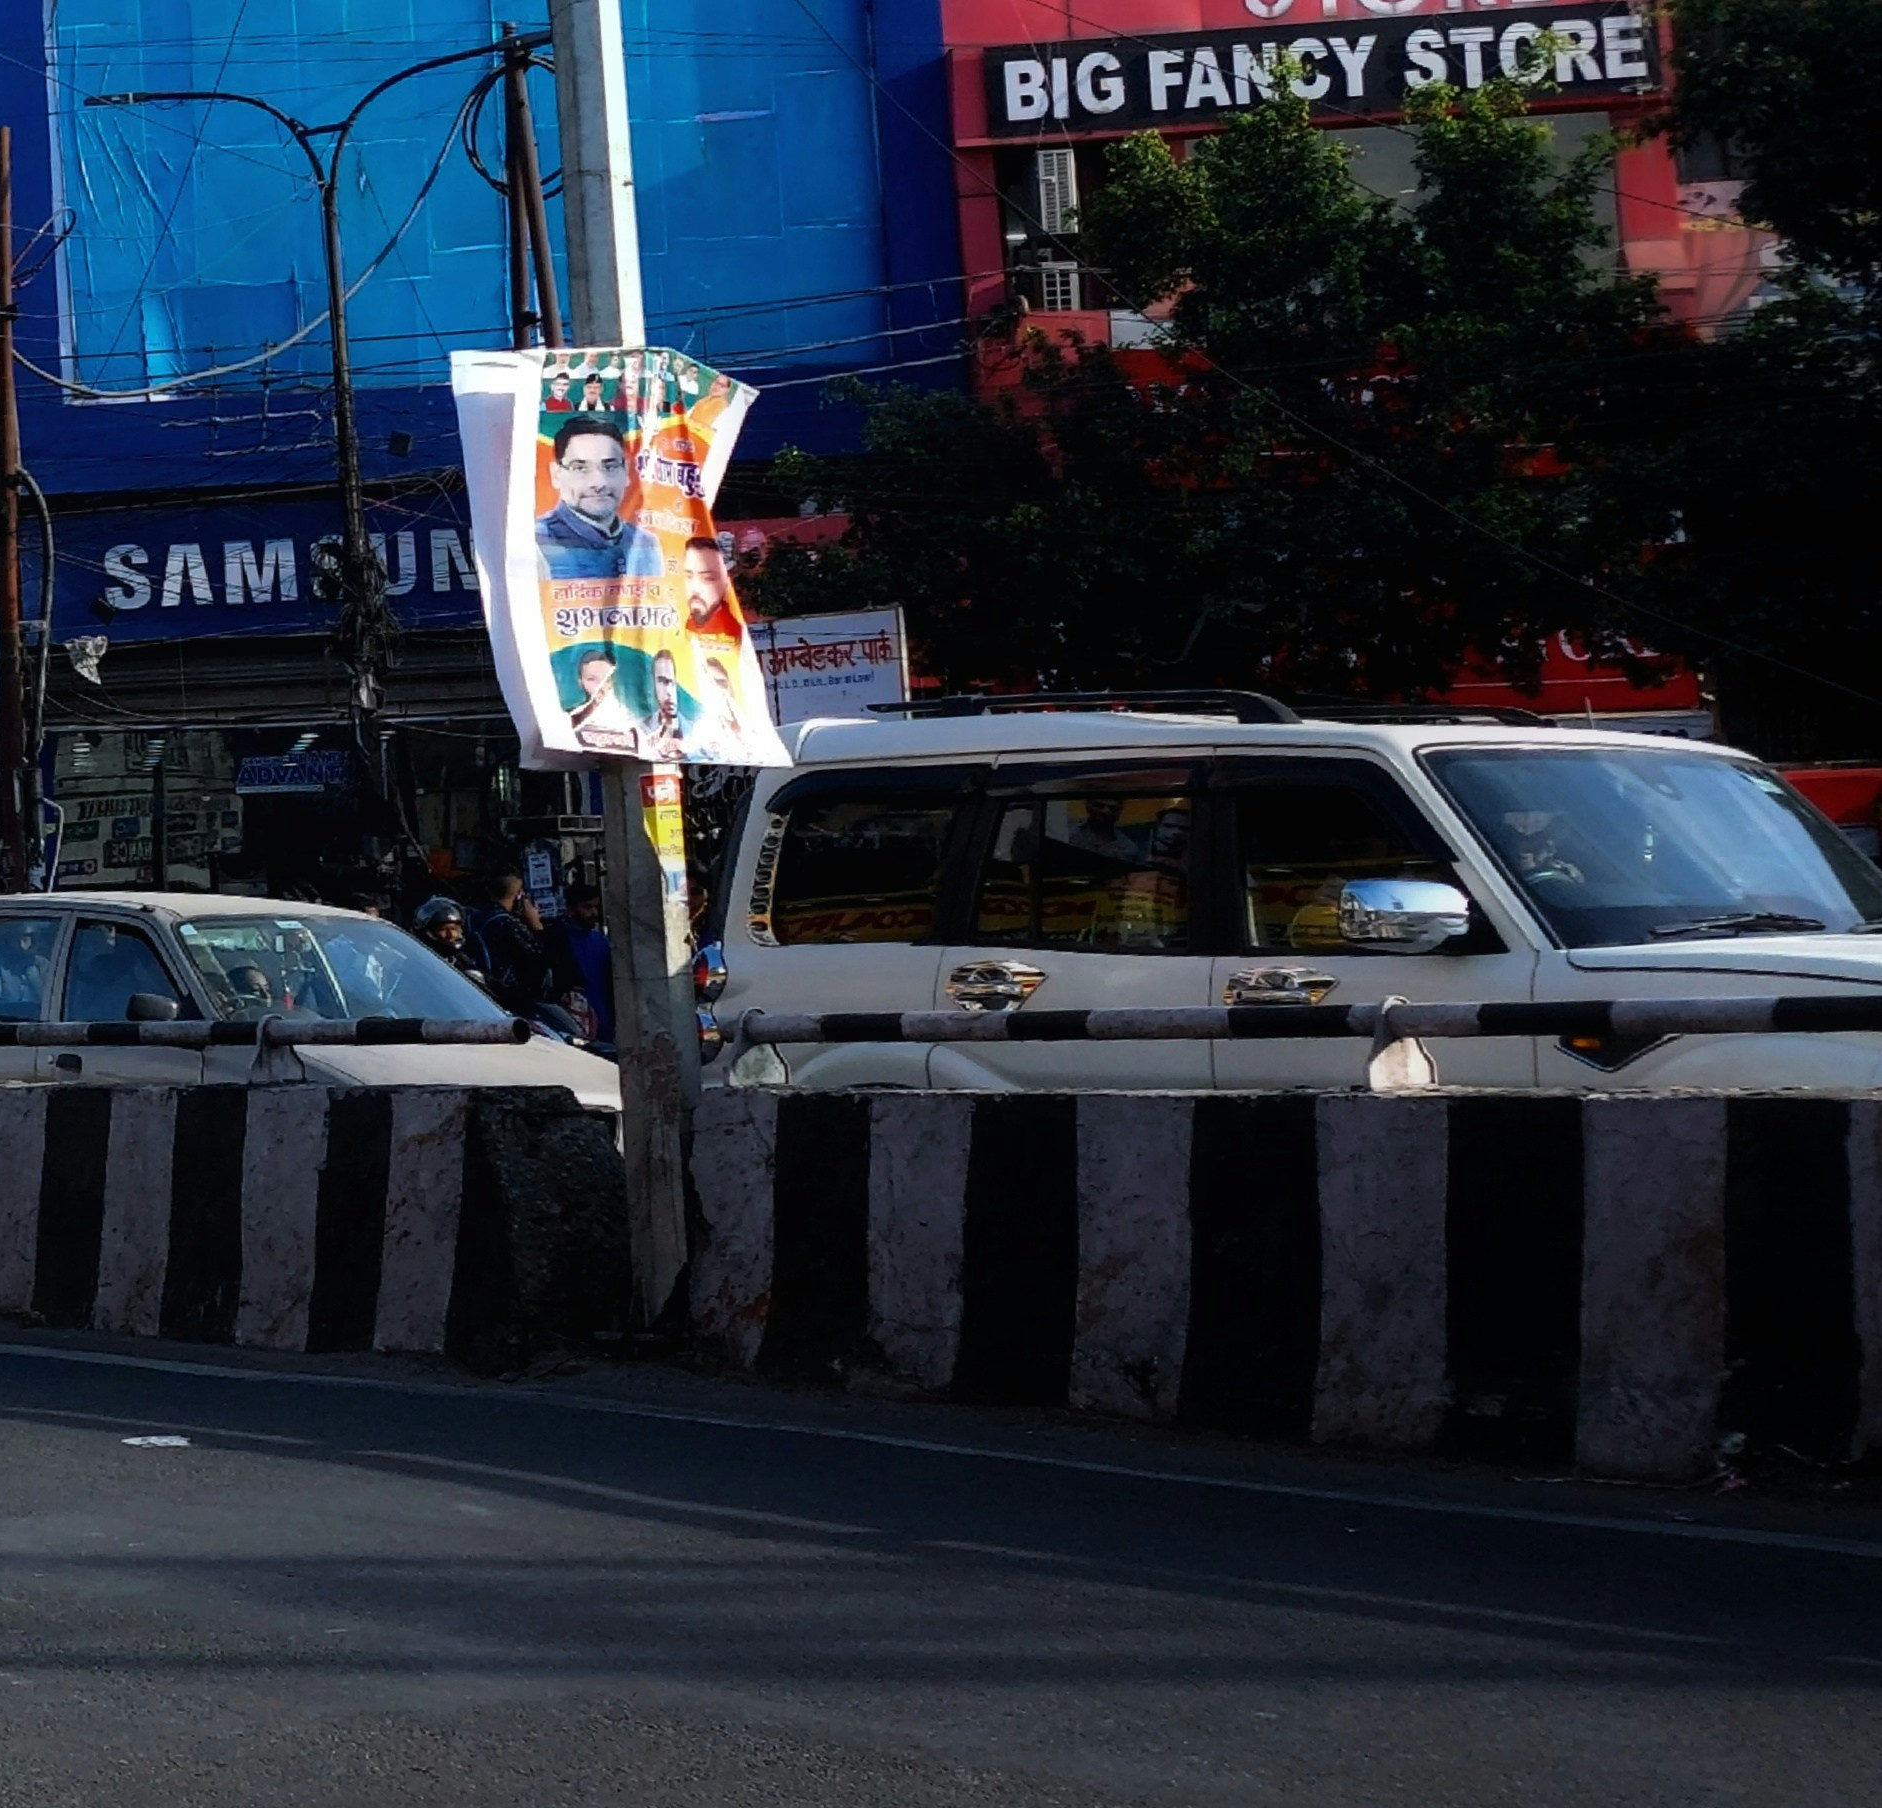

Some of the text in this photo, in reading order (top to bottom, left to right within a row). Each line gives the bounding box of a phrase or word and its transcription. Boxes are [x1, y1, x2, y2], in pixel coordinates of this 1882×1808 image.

[1003, 13, 1649, 121] BIG FANCY STORE
[103, 528, 479, 610] SAMSUN
[859, 629, 893, 665] पार्क
